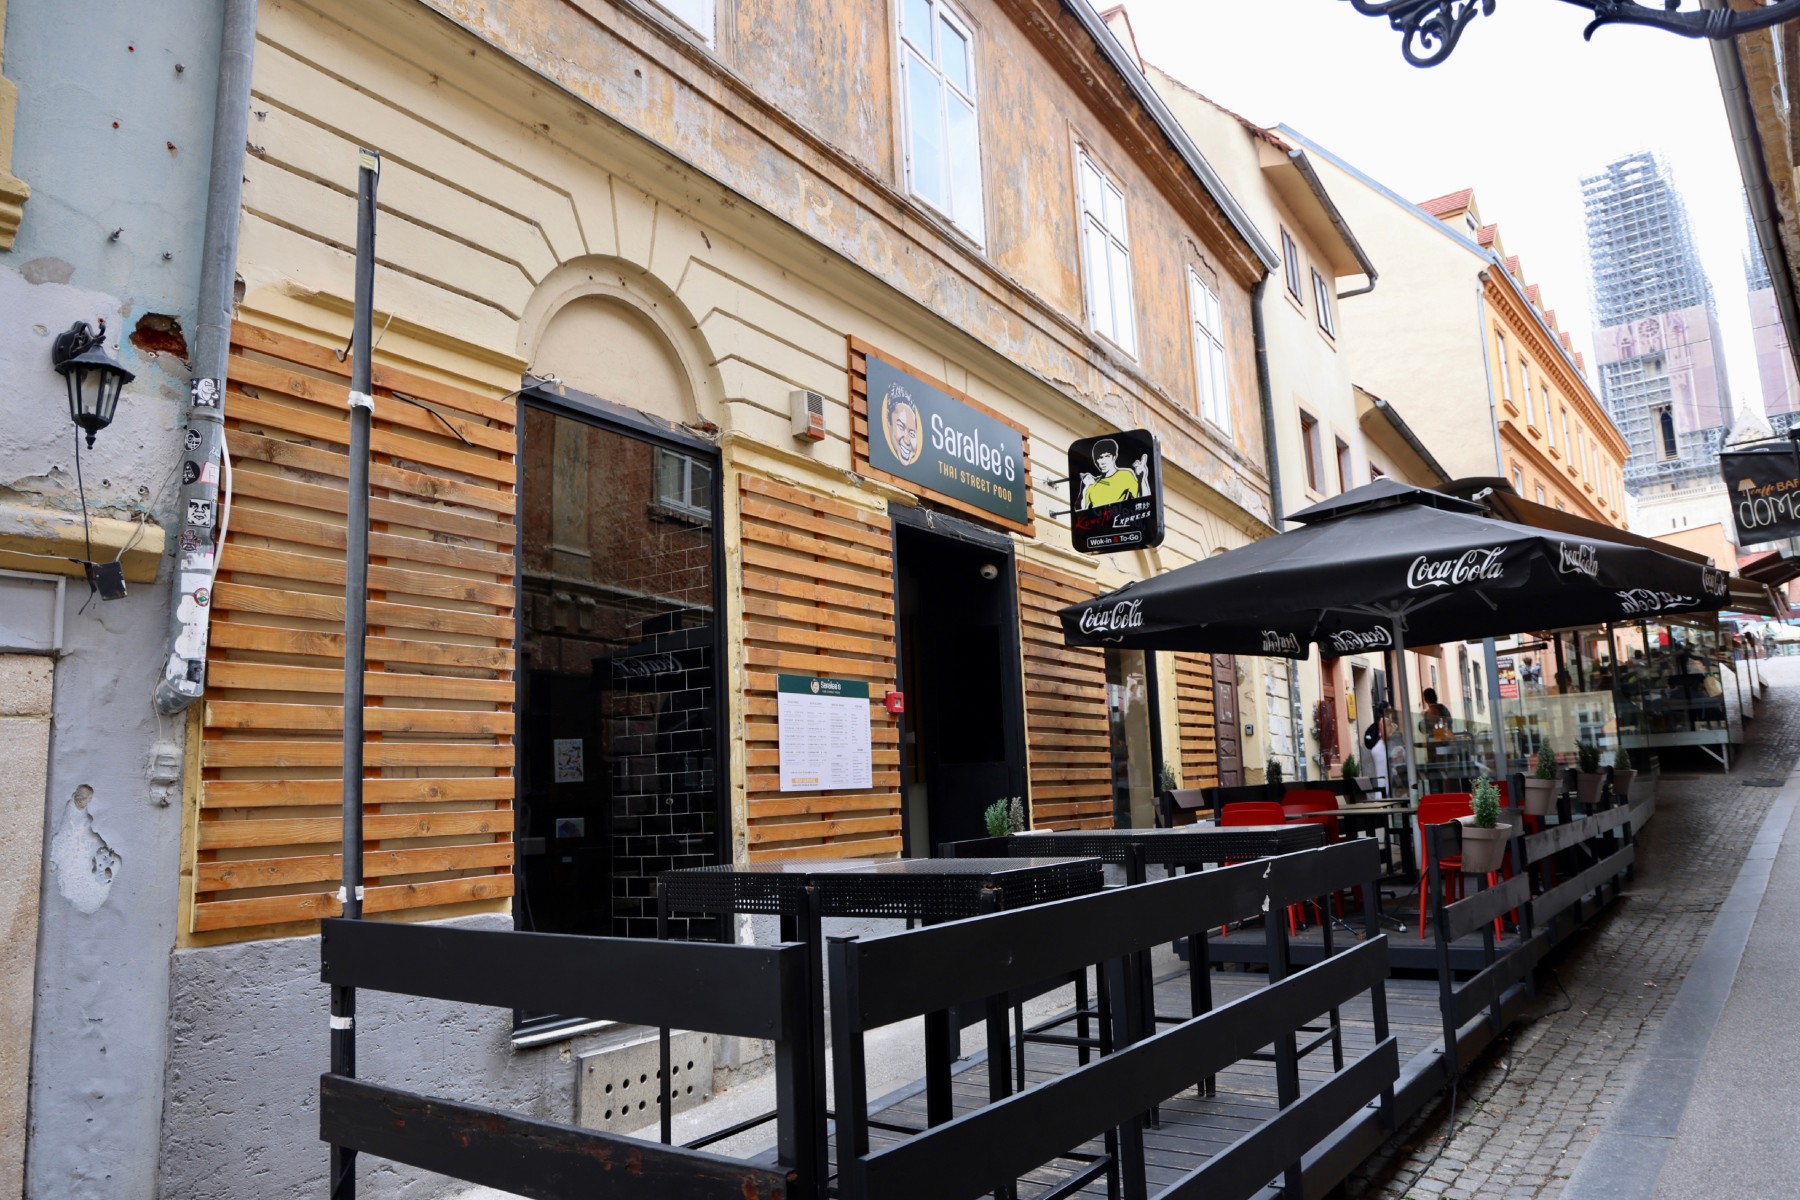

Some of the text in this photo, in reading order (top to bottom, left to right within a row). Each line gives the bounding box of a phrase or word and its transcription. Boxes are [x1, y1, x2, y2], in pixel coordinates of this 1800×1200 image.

[931, 413, 1015, 482] Saralee's
[938, 460, 1012, 502] THAI STREET FOOD
[1090, 537, 1112, 546] Wok-in
[1120, 533, 1139, 542] To-Go
[1407, 546, 1507, 589] Coca-Cola
[1080, 598, 1144, 634] Coca-Cola
